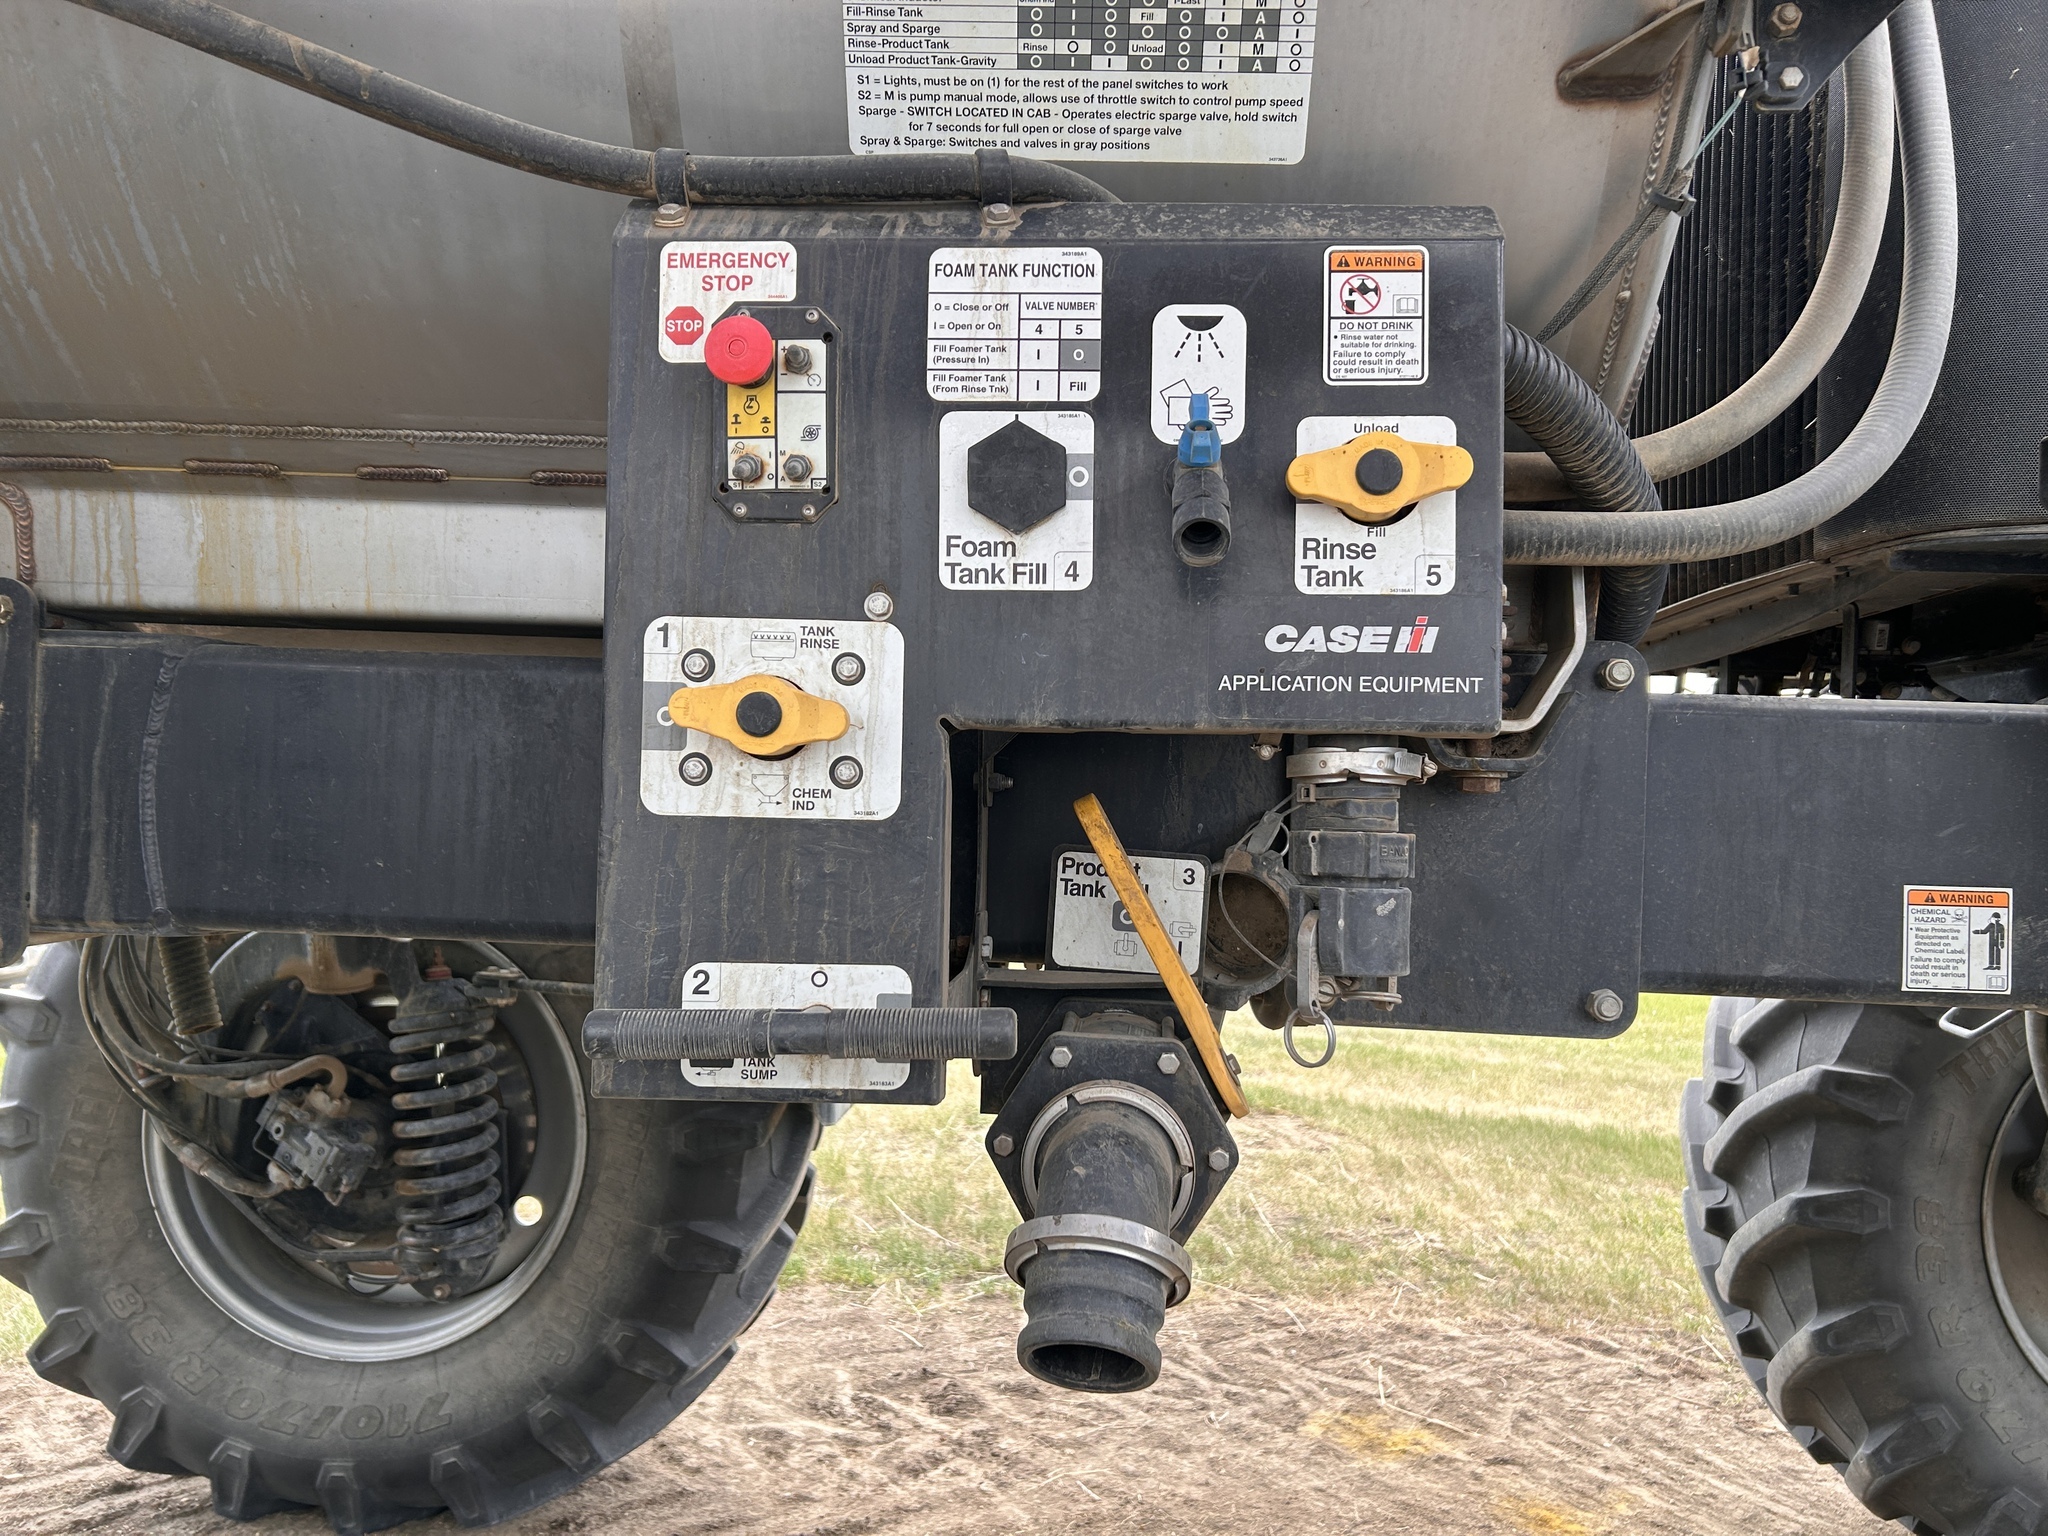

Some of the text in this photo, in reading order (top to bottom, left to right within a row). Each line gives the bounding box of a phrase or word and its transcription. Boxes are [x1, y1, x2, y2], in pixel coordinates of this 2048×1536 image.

[846, 7, 922, 17] Fill-Rinse Tank
[847, 23, 940, 35] Spray and Sparge
[848, 38, 949, 49] Rinse-Product Tank
[1023, 43, 1047, 51] Rinse
[1132, 44, 1163, 52] Unload
[848, 54, 996, 67] Unload Product Tank-Gravity
[857, 74, 869, 84] S1
[884, 75, 920, 87] Lights,
[924, 76, 950, 86] must
[953, 76, 966, 86] be
[987, 76, 999, 88] (1)
[1004, 77, 1019, 87] for
[1023, 77, 1039, 87] the
[1043, 78, 1064, 87] rest
[1067, 78, 1078, 87] of
[1082, 78, 1098, 88] the
[1102, 78, 1132, 90] panel
[1135, 79, 1183, 89] switches
[1187, 80, 1197, 89] to
[1201, 80, 1228, 90] work
[858, 90, 871, 100] S2
[884, 90, 894, 100] M
[898, 91, 906, 100] is
[910, 93, 940, 103] pump
[944, 91, 982, 101] manual
[986, 92, 1019, 103] mode,
[1022, 93, 1057, 103] allows
[1083, 94, 1094, 103] of
[1097, 94, 1136, 104] throttle
[1140, 94, 1175, 104] switch
[1178, 96, 1189, 105] to
[1193, 95, 1231, 105] control
[1235, 98, 1266, 108] pump
[1270, 96, 1303, 108] speed
[858, 105, 1296, 122] Sparge SWITCH LOCATED IN CAB Operates electric sparge valve, hold switch
[860, 135, 1149, 151] Spray Sparge: Switches and valves in gray positions
[667, 252, 789, 268] EMERGENCY
[1354, 256, 1415, 266] WARNING
[935, 263, 1094, 277] FOAM TANK FUNCTION
[702, 275, 752, 291] STOP
[952, 303, 979, 311] Close
[994, 303, 1008, 311] Off
[1025, 301, 1094, 310] VALVE NUMBER
[667, 319, 701, 332] STOP
[947, 322, 972, 331] Open
[1035, 324, 1042, 334] 4
[1075, 324, 1082, 334] 5
[1340, 322, 1354, 330] DO
[1374, 350, 1405, 358] comply
[933, 356, 989, 364] (Pressure In)
[1378, 366, 1403, 375] injury.
[932, 385, 958, 394] (From
[988, 385, 1008, 394] Tnk)
[1070, 381, 1086, 390] Fill
[1354, 423, 1398, 433] Unload
[1367, 527, 1385, 536] Fill
[946, 535, 1017, 557] Foam
[1302, 537, 1376, 559] Rinse
[944, 562, 1046, 584] Tank Fill
[1064, 560, 1079, 581] 4
[1300, 565, 1363, 586] Tank
[1426, 564, 1441, 586] 5
[657, 622, 668, 647] 1
[800, 626, 834, 636] TANK
[800, 638, 839, 649] RINSE
[1264, 624, 1392, 652] CASE
[1218, 675, 1483, 693] APPLICATION EQUIPMENT
[792, 788, 831, 798] CHEM
[792, 800, 814, 810] IND
[1183, 868, 1195, 884] 3
[1060, 877, 1106, 898] Tank
[1939, 894, 1993, 903] WARNING
[692, 969, 709, 994] 2
[743, 1058, 774, 1067] TANK
[741, 1069, 777, 1079] SUMP
